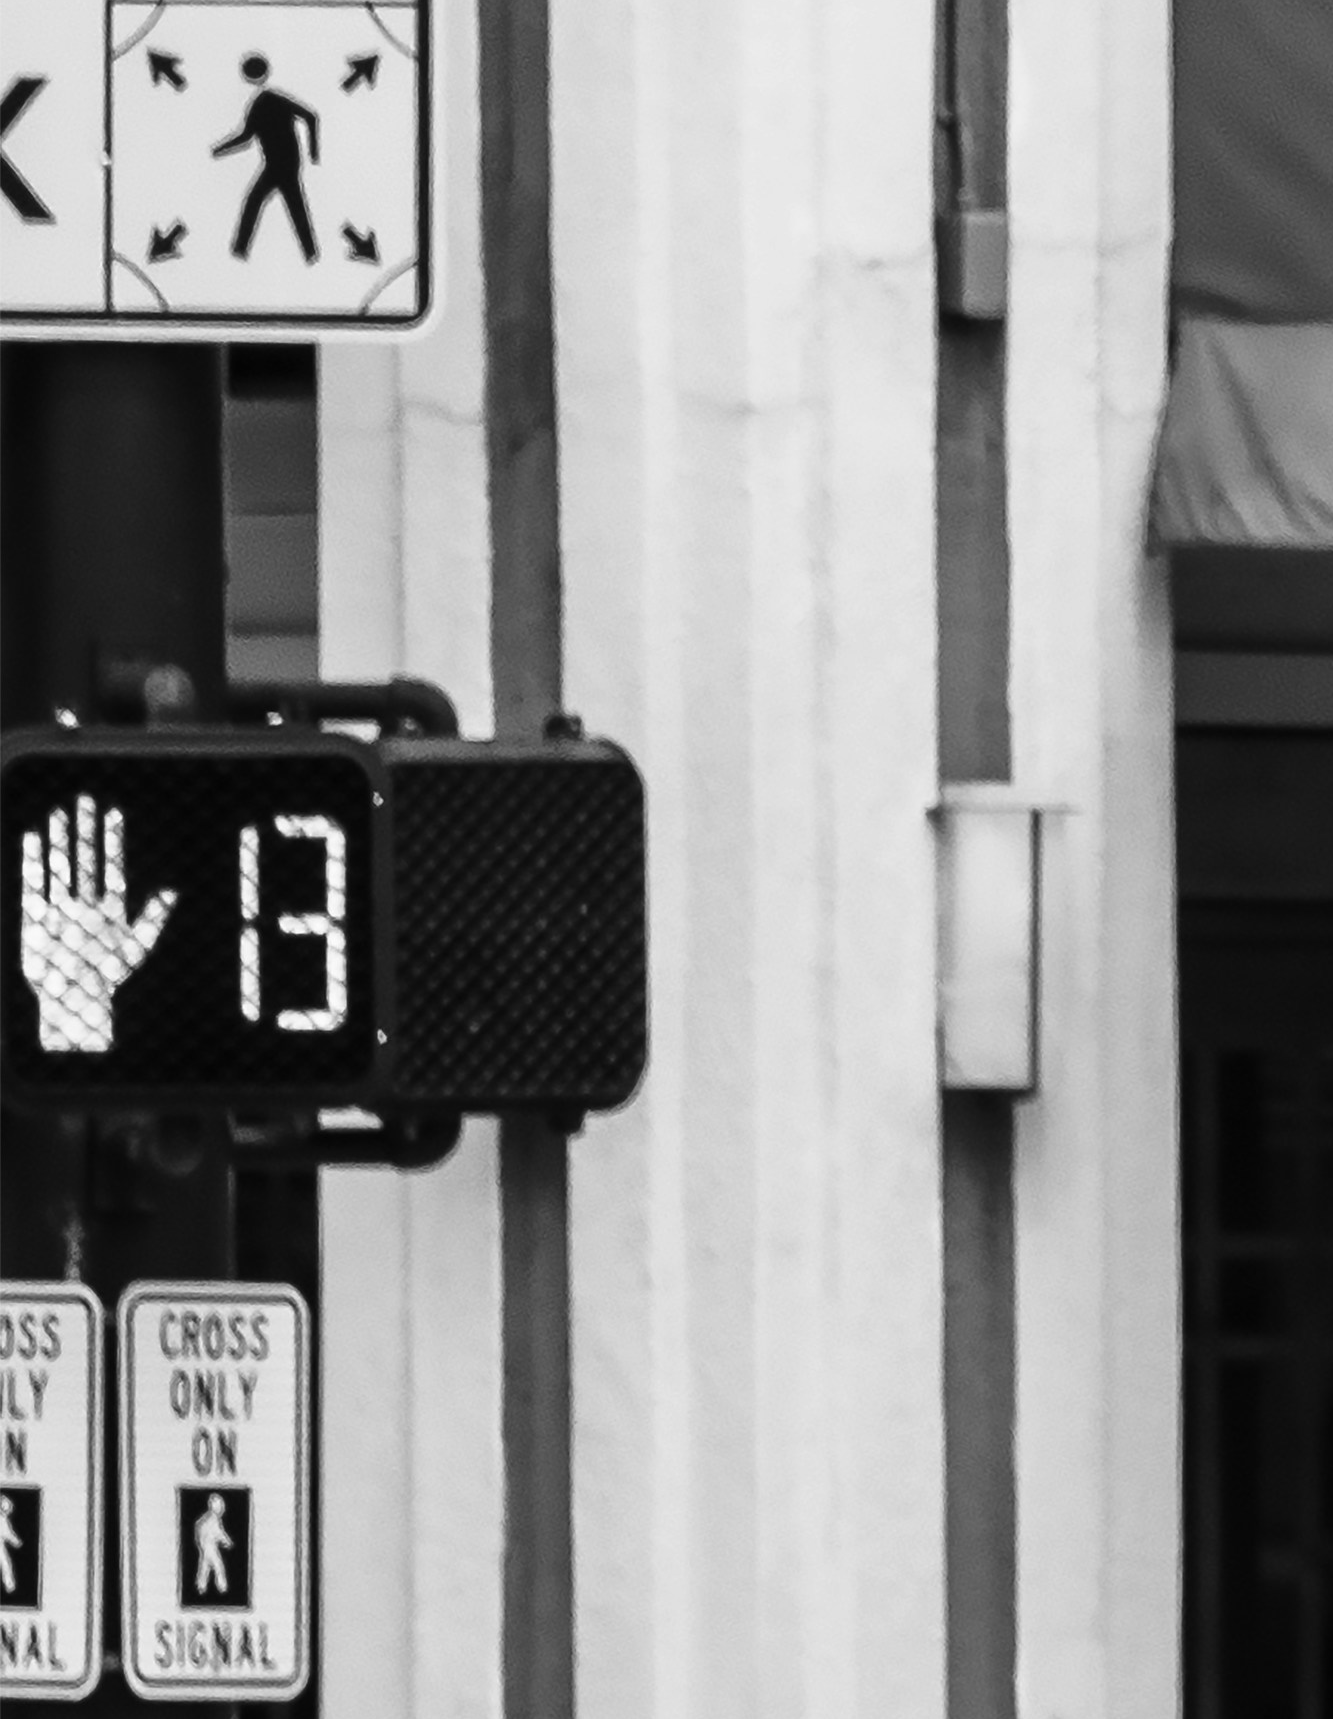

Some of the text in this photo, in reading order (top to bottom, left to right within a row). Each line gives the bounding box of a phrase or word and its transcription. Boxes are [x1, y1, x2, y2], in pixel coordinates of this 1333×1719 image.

[240, 814, 346, 1030] 13
[159, 1310, 269, 1361] CROSS
[169, 1369, 258, 1421] ONLY
[191, 1426, 237, 1477] ON
[154, 1619, 277, 1672] SIGNAL
